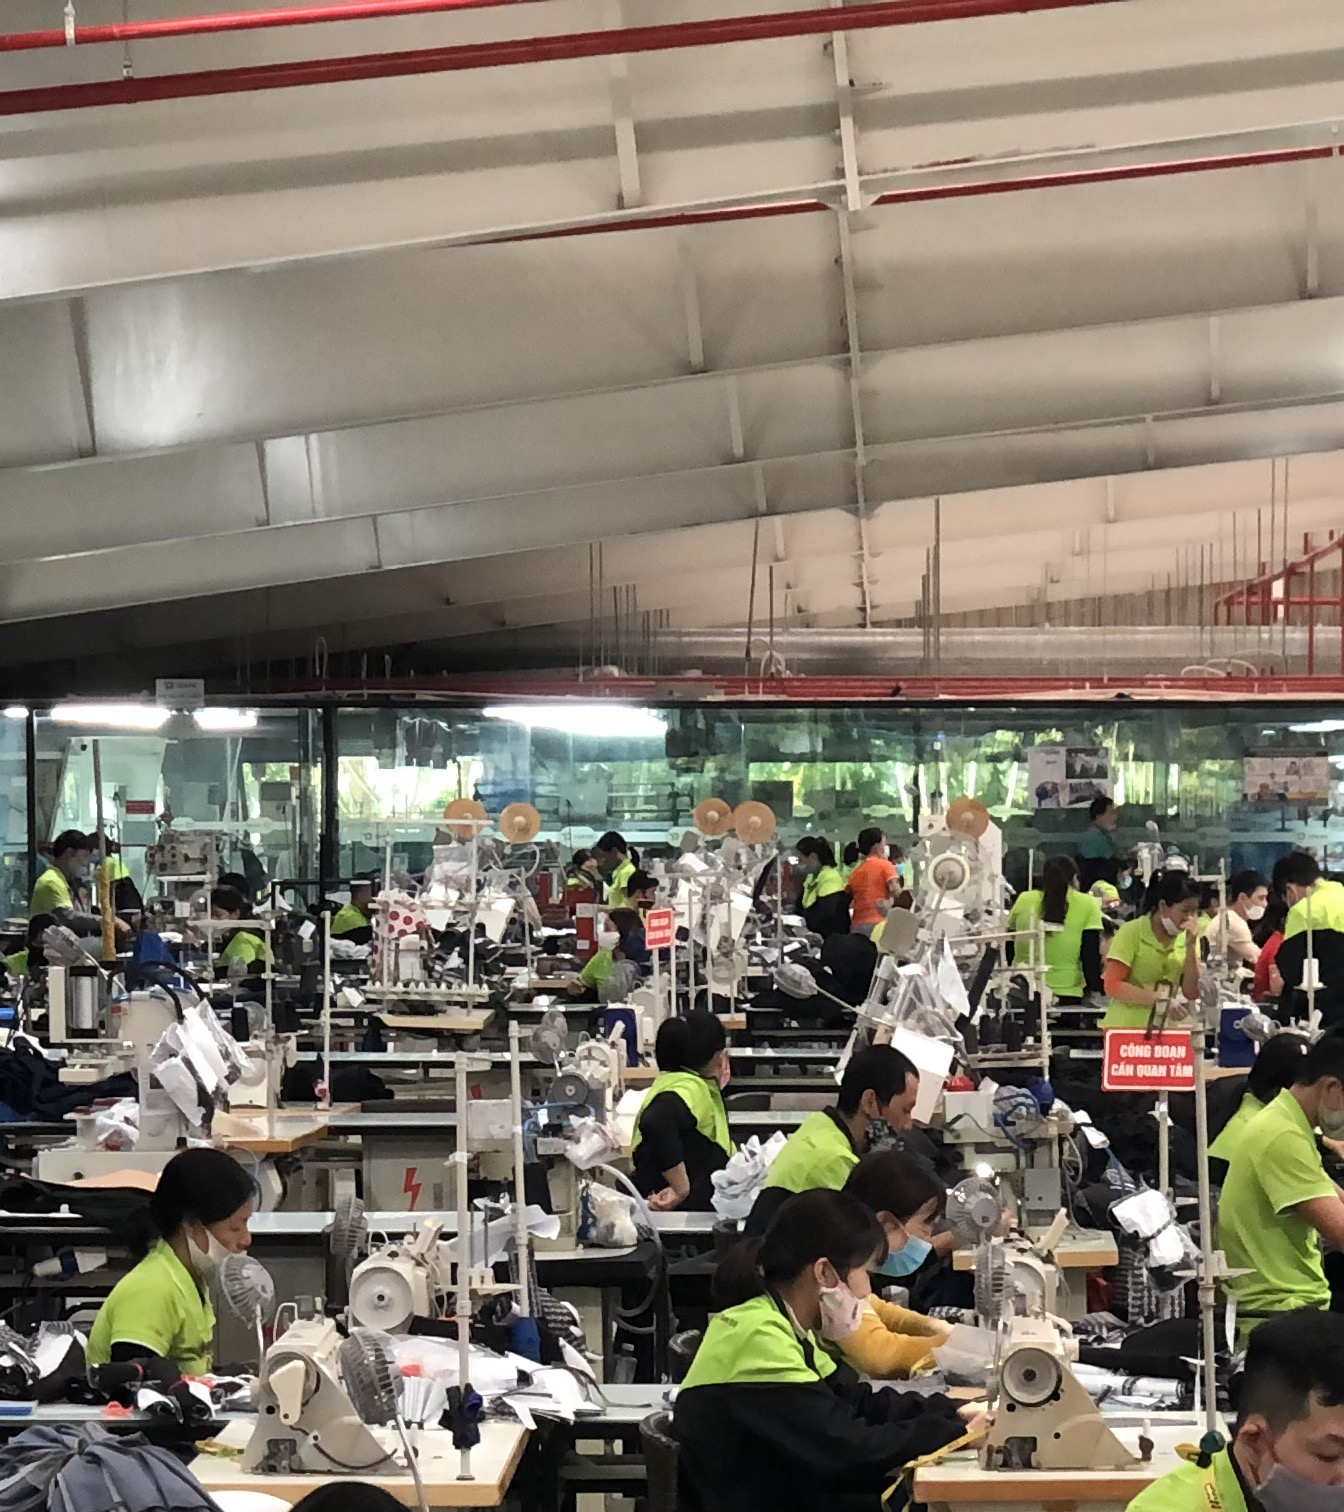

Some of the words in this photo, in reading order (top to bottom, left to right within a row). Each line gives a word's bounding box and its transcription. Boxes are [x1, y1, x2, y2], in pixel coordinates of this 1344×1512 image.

[1119, 1042, 1152, 1058] CÔNG
[1136, 1064, 1168, 1078] QUAN
[1169, 1062, 1194, 1077] TÂM
